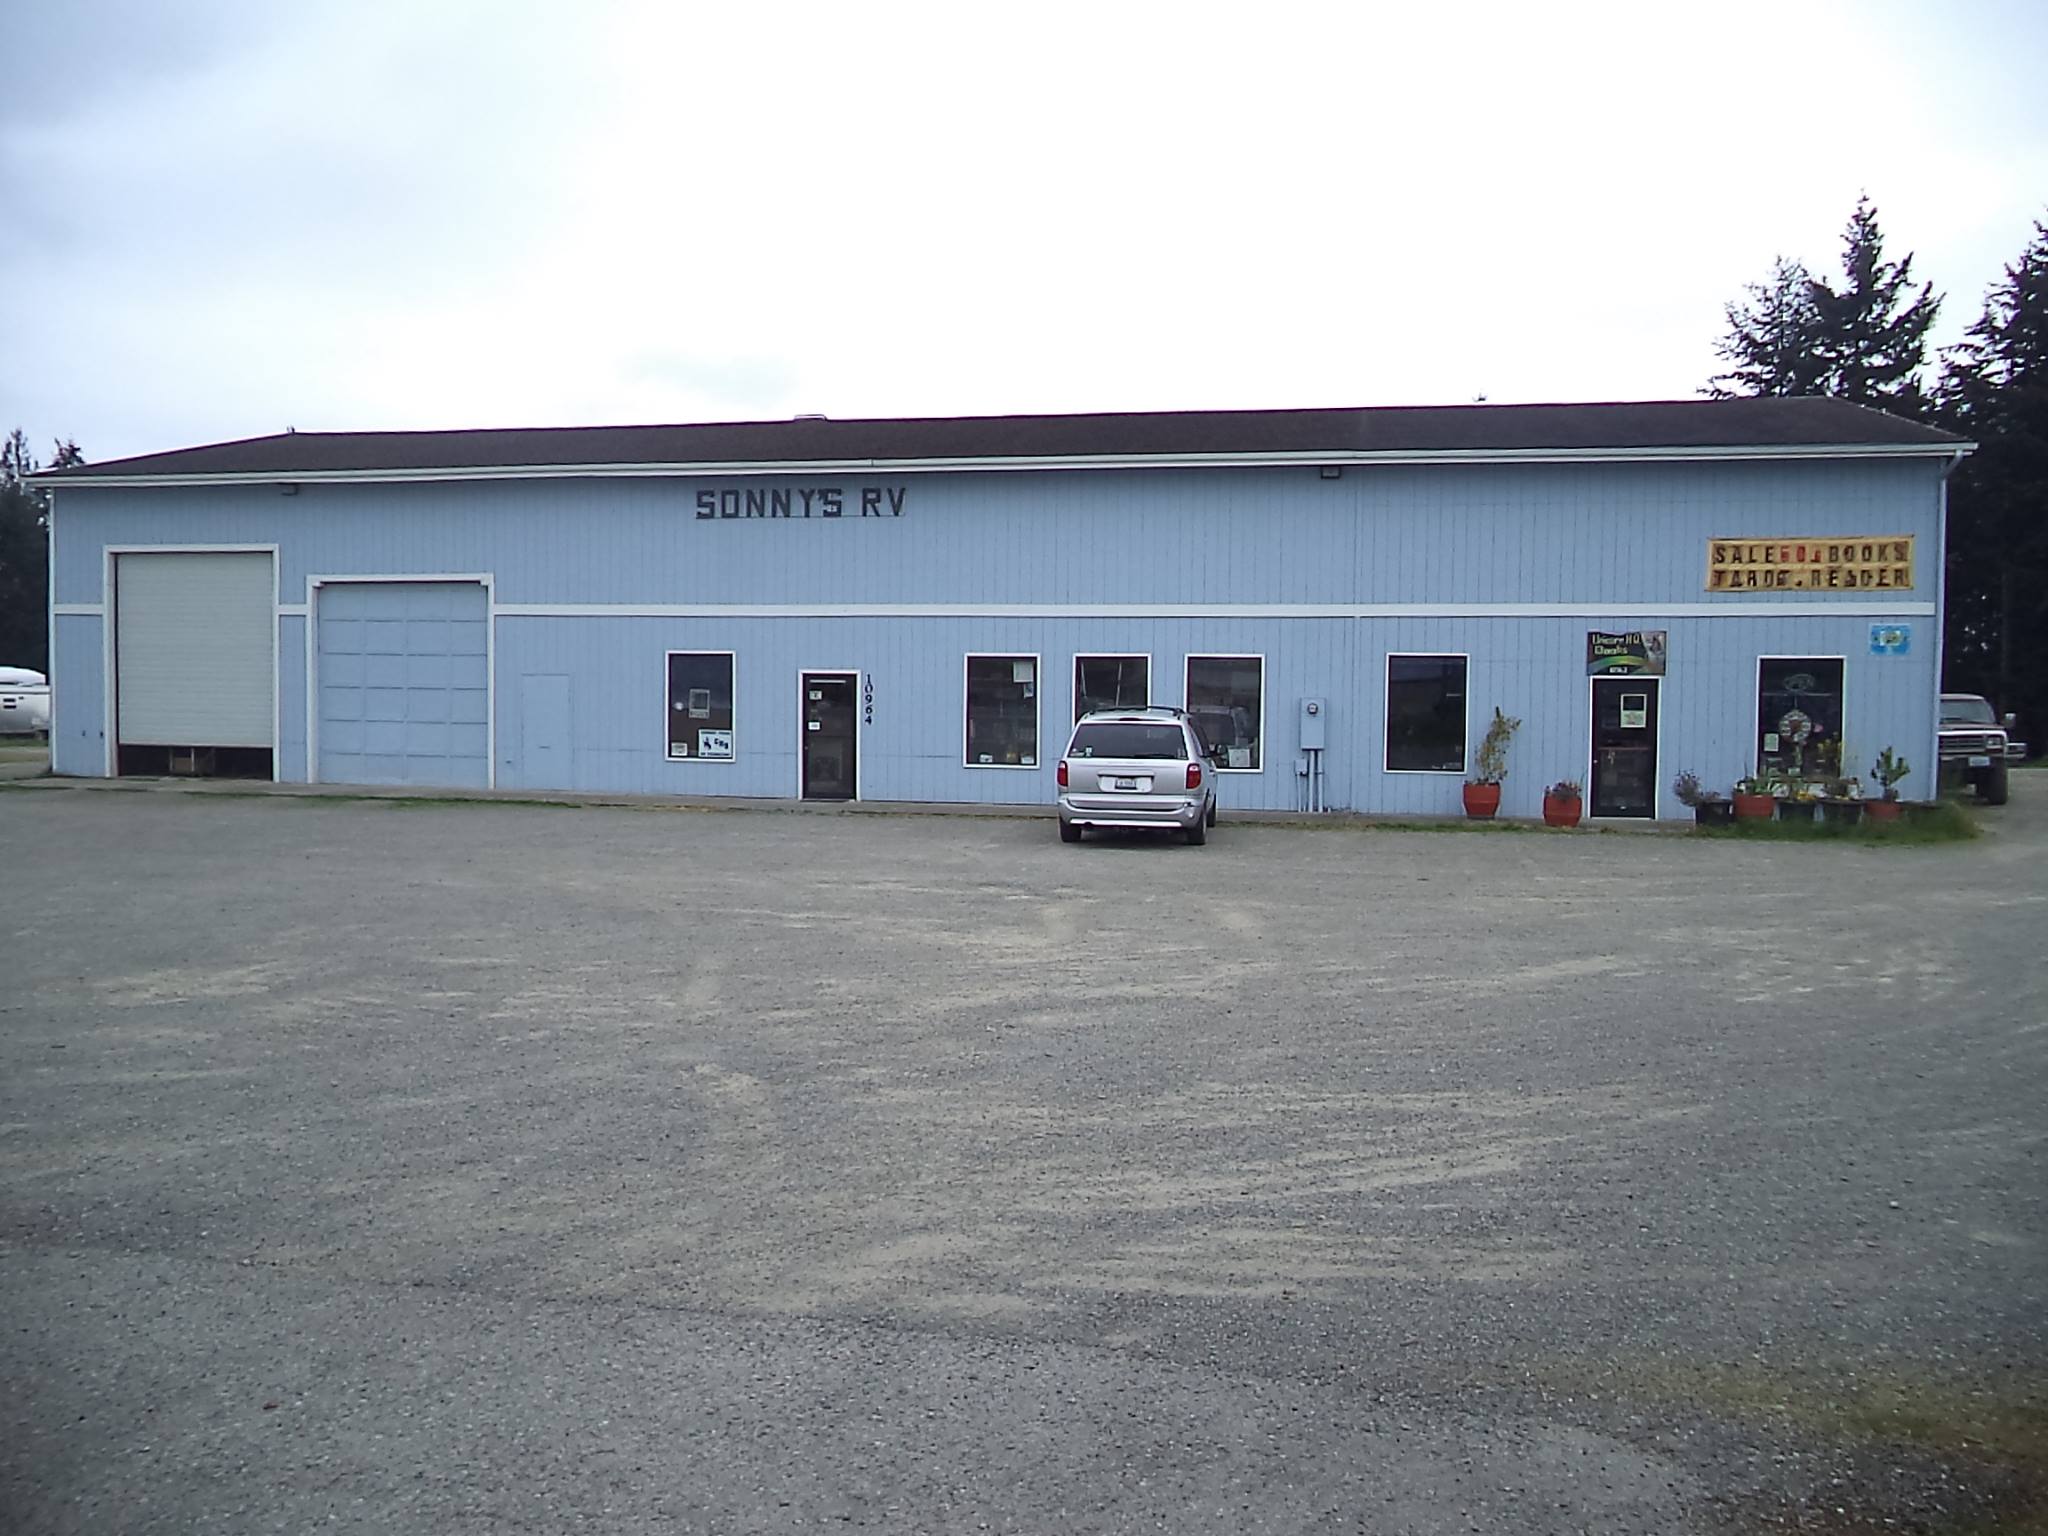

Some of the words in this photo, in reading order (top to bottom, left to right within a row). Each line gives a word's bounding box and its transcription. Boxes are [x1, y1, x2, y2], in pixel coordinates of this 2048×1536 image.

[696, 488, 842, 518] SONNY'S
[862, 487, 906, 517] RV
[1713, 543, 1773, 563] SALE
[1829, 542, 1908, 562] BOOKS
[865, 674, 873, 725] 10964
